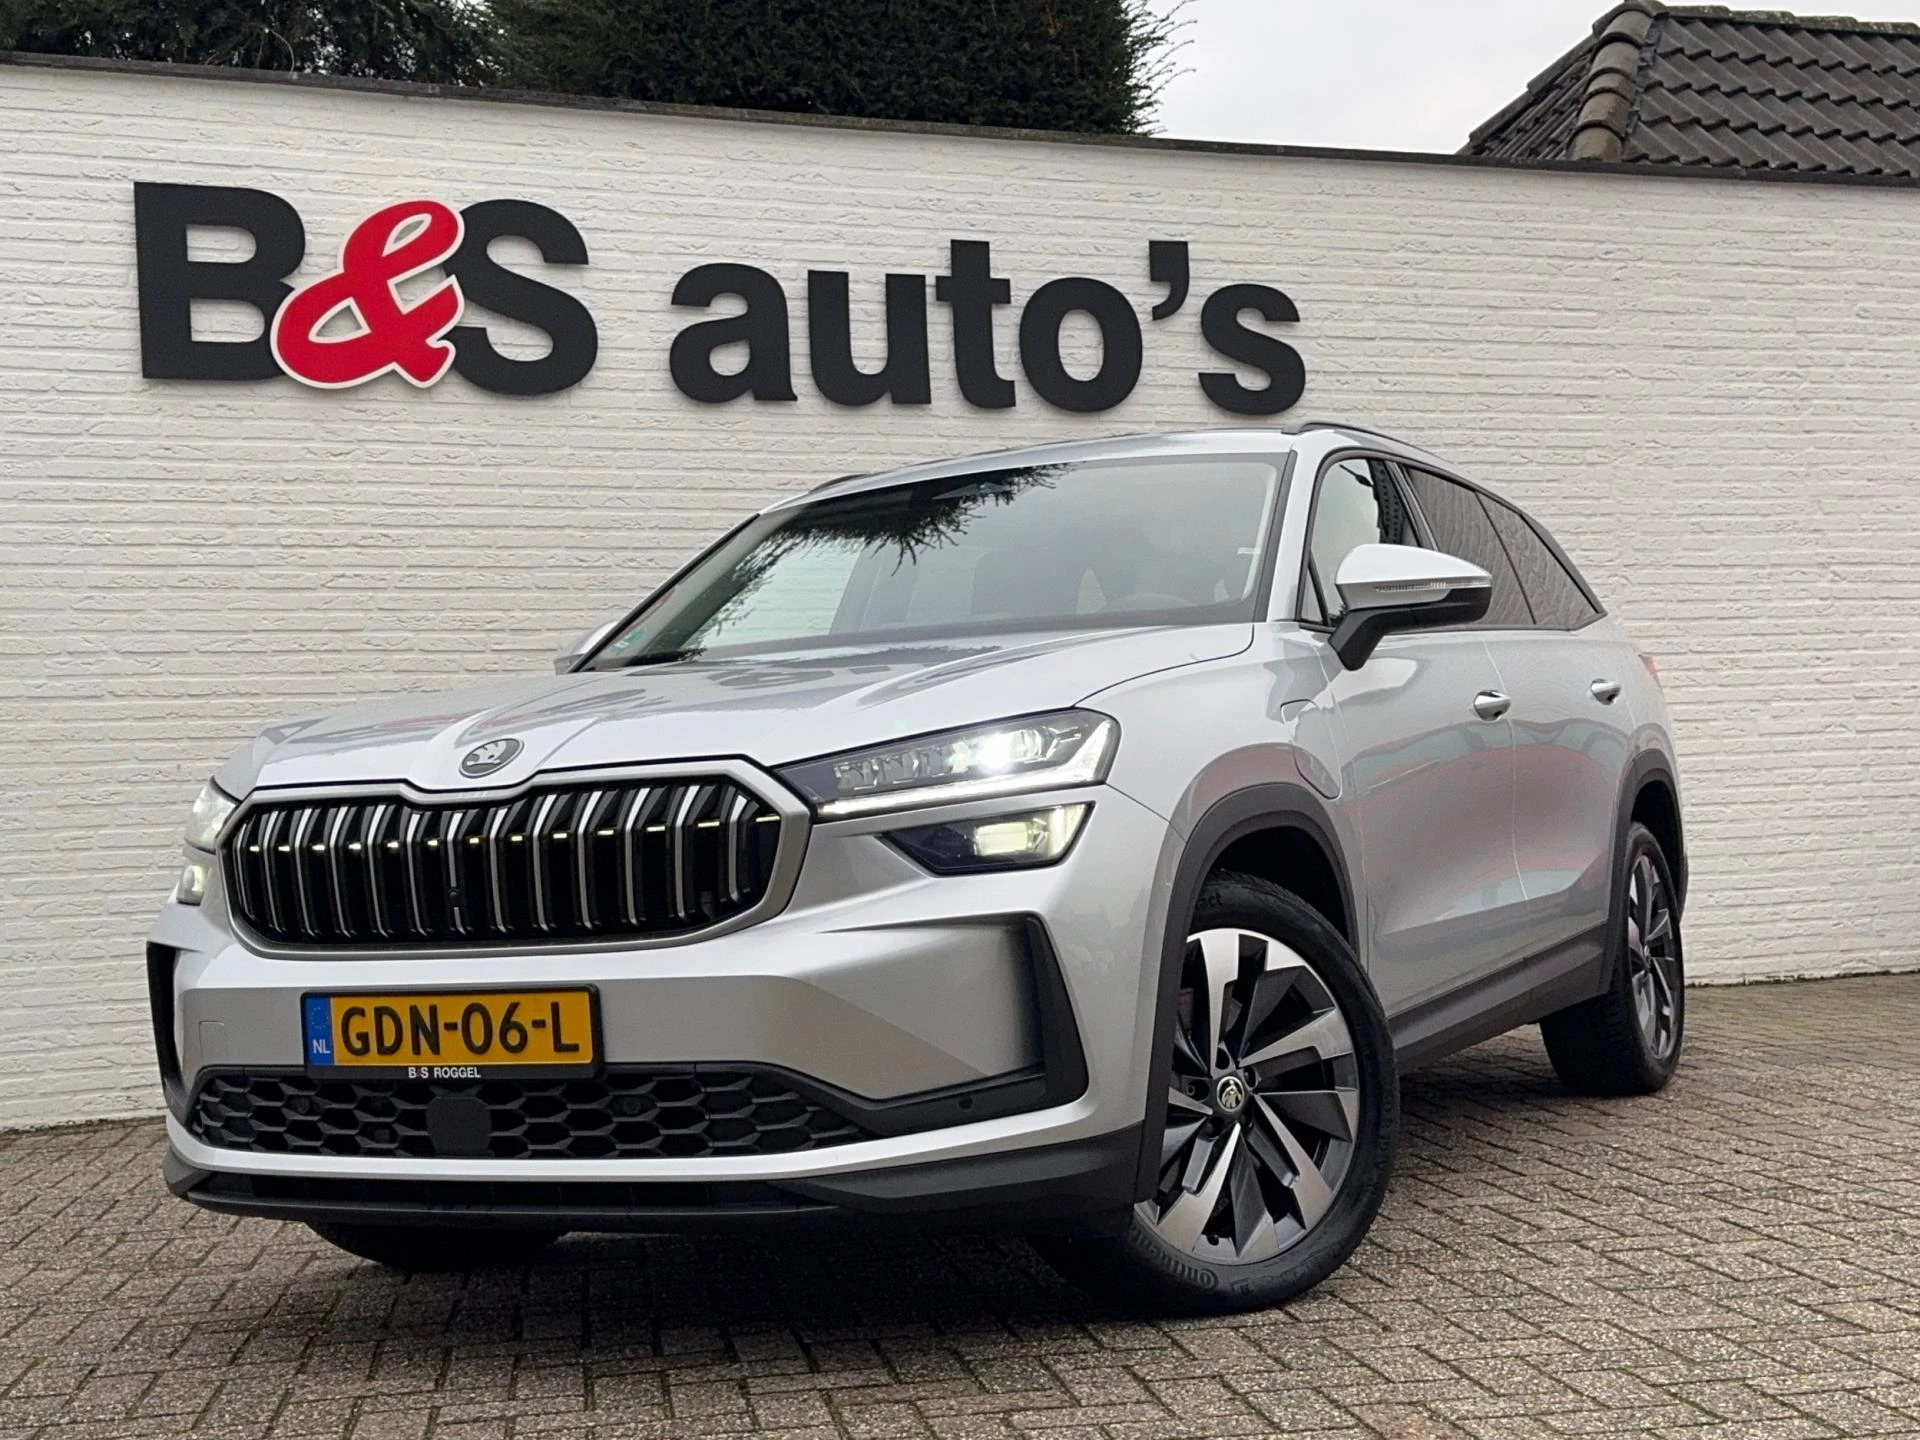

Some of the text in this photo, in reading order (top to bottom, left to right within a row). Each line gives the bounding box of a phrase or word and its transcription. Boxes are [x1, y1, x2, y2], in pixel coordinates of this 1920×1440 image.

[134, 182, 1305, 415] B&S auto's
[312, 1039, 331, 1054] NL
[341, 1001, 580, 1057] GDN-06-L
[408, 1066, 481, 1079] BS ROGGEL
[1125, 1224, 1219, 1291] Continenta
